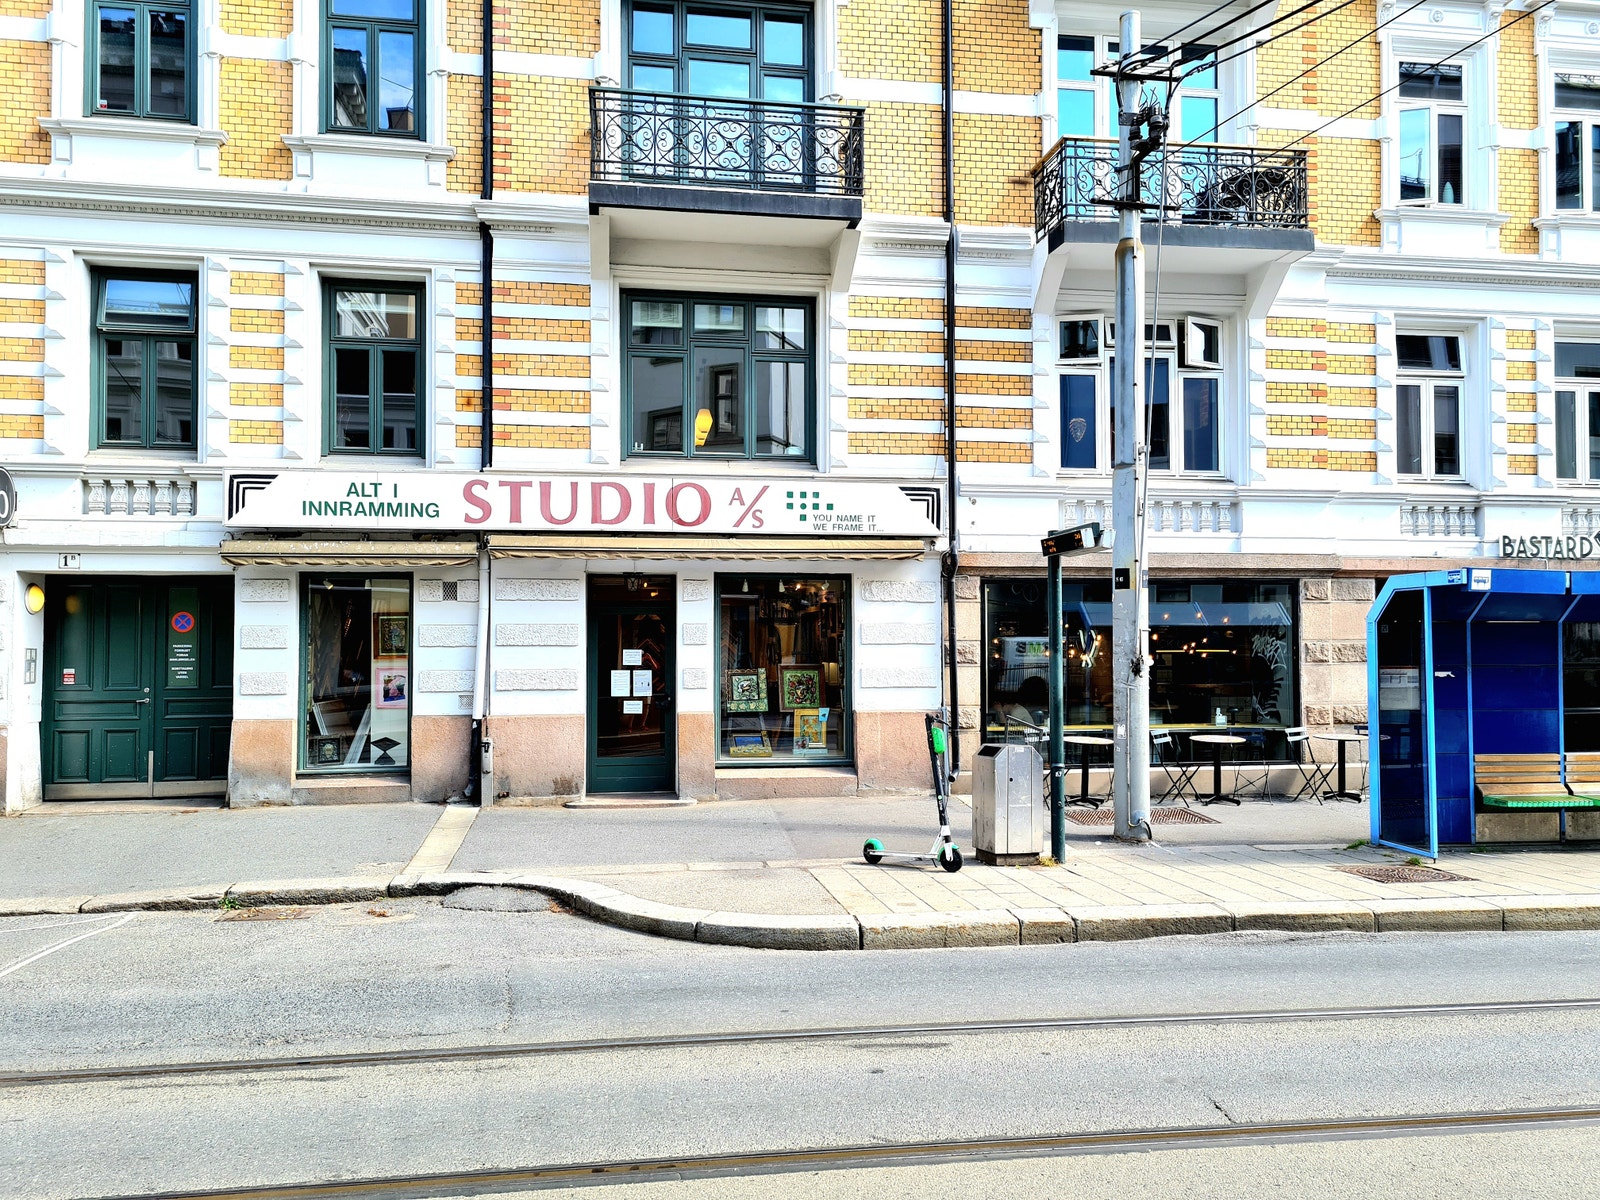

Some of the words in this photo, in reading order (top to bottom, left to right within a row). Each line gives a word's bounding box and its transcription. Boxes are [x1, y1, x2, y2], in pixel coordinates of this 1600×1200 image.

[346, 482, 382, 498] ALT
[393, 483, 398, 498] I
[302, 500, 440, 518] INNRAMMING
[463, 480, 712, 527] STUDIO
[728, 485, 770, 529] A/S
[813, 514, 832, 522] YOU
[836, 514, 863, 522] NAME
[867, 514, 876, 523] IT
[813, 523, 828, 531] WE
[832, 523, 864, 532] FRAME
[868, 524, 884, 532] IT...
[1502, 535, 1593, 559] BASTARD
